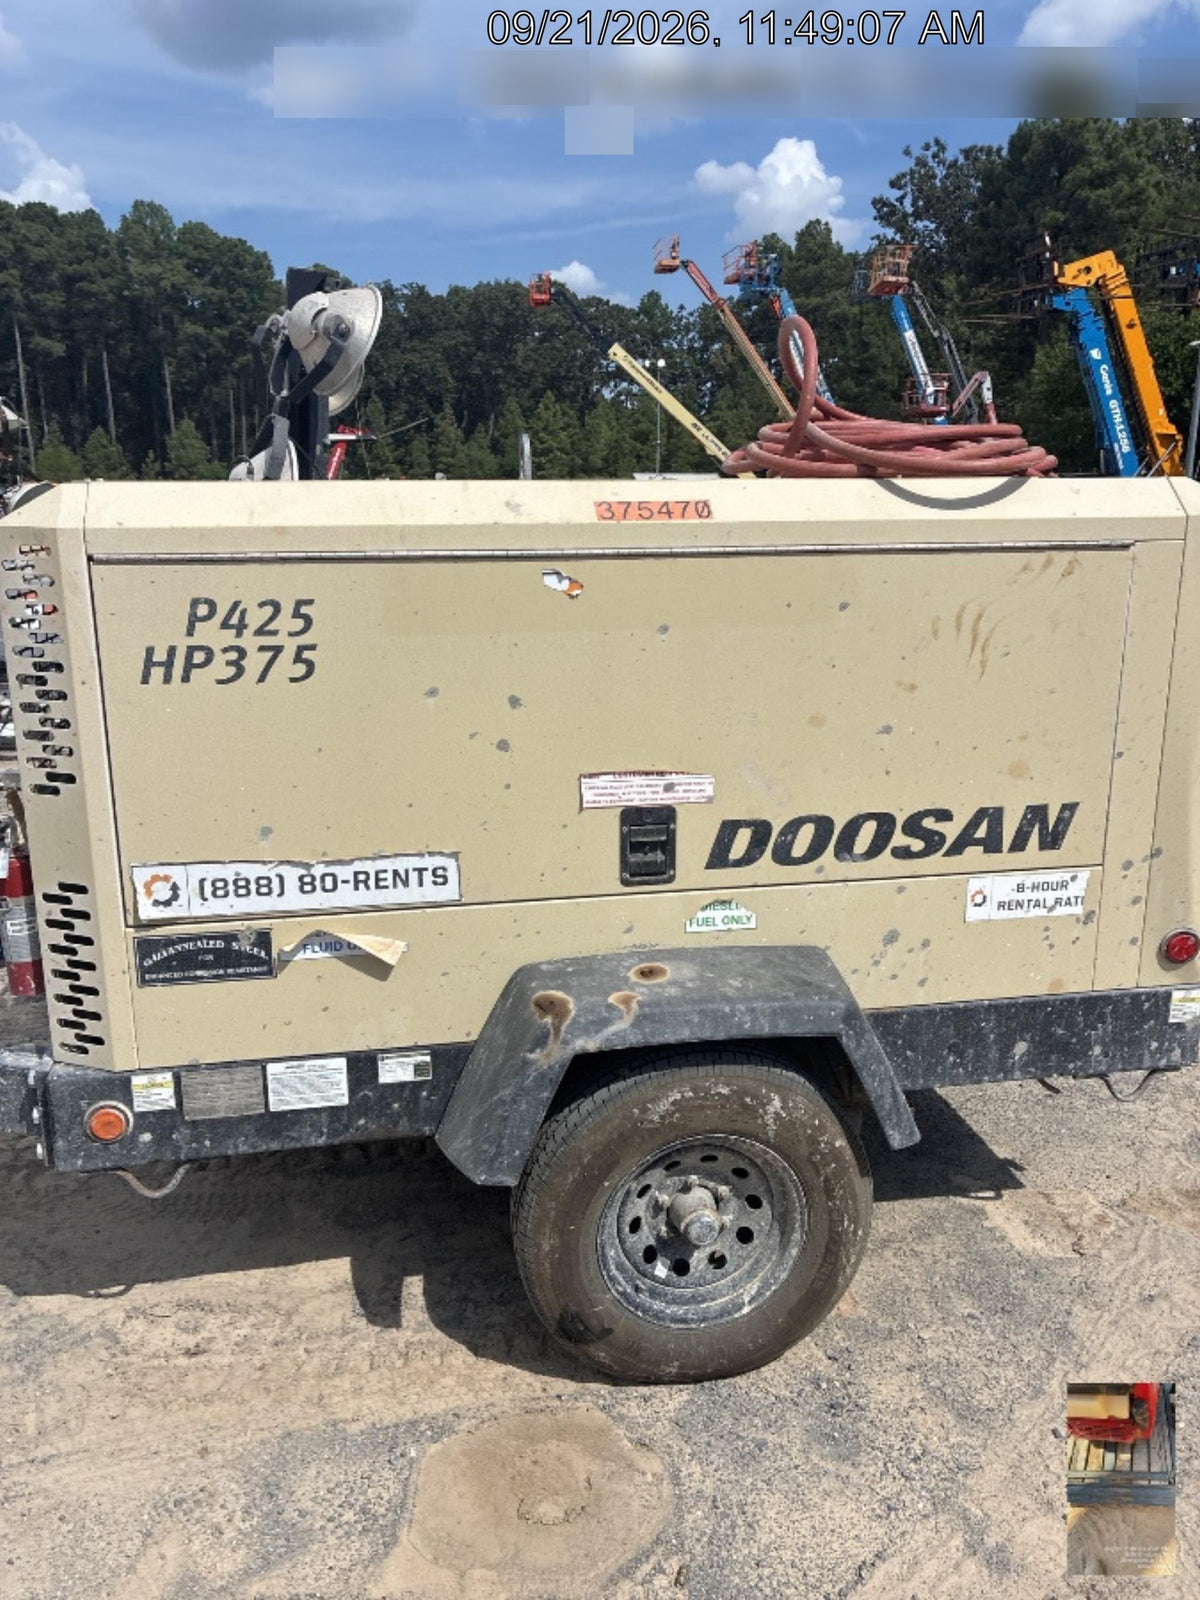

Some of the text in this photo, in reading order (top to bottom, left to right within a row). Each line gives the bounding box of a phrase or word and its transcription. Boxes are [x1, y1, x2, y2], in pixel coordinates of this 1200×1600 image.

[185, 597, 315, 639] P425
[139, 643, 318, 685] HP375
[704, 802, 1080, 870] DOOSAN
[198, 866, 449, 903] (888) 80-RENTS
[721, 914, 753, 925] ONLY
[303, 941, 342, 954] FLUID
